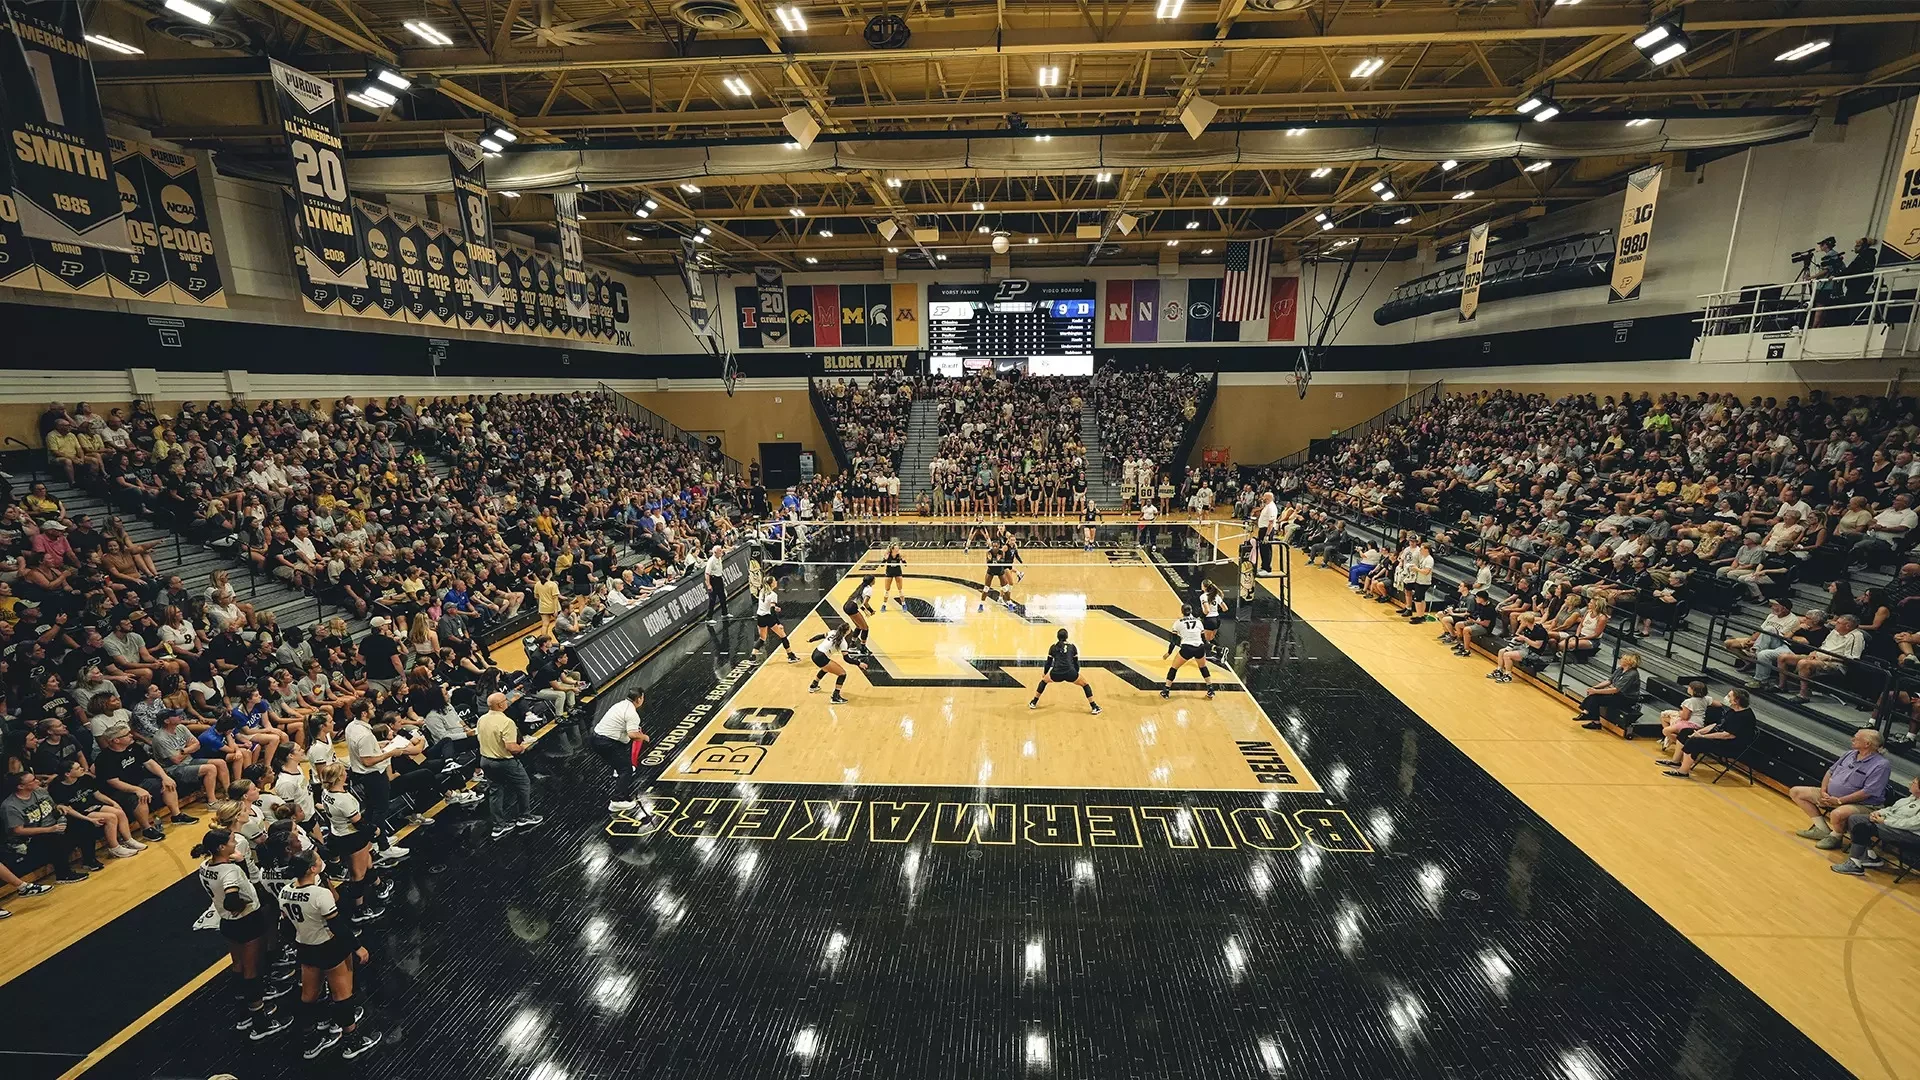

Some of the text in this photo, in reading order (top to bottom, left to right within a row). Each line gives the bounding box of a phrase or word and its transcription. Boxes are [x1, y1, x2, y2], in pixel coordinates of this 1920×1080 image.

[33, 17, 64, 35] TEAM
[24, 50, 65, 126] 1
[285, 71, 324, 99] PURDUE
[25, 122, 86, 146] MARIANNE
[284, 119, 342, 149] ALL-AMERICAN
[293, 115, 331, 132] FIRST TEAM
[12, 129, 108, 181] SMITH
[150, 148, 186, 167] PURDUE
[291, 139, 348, 202] 20
[52, 192, 92, 216] 1985
[166, 201, 196, 217] NCAA
[303, 204, 354, 237] LYNCH
[467, 194, 487, 238] 8
[126, 218, 159, 247] 05
[159, 225, 215, 256] 2006
[465, 241, 498, 267] TURNER
[1619, 231, 1650, 257] 1980
[178, 251, 204, 264] SWEET
[323, 247, 346, 264] 2008
[188, 262, 199, 272] 16
[368, 258, 398, 282] 2010
[401, 265, 425, 287] 2011
[426, 271, 452, 292] 2012
[1464, 271, 1482, 289] 1979
[500, 286, 518, 303] 2016
[519, 289, 537, 306] 2017
[760, 292, 783, 314] 20
[1058, 303, 1068, 315] 9
[760, 316, 787, 325] CLEVELAND
[823, 354, 908, 369] BLOCK PARTY
[1772, 349, 1778, 357] 3
[1121, 486, 1136, 494] LET'S
[1140, 488, 1153, 498] GO
[642, 606, 673, 638] HOME
[668, 598, 682, 618] OF
[678, 582, 709, 615] PURDUE
[1184, 620, 1197, 631] 17
[605, 796, 1376, 854] BOILERMAKERS
[282, 902, 305, 923] 19
